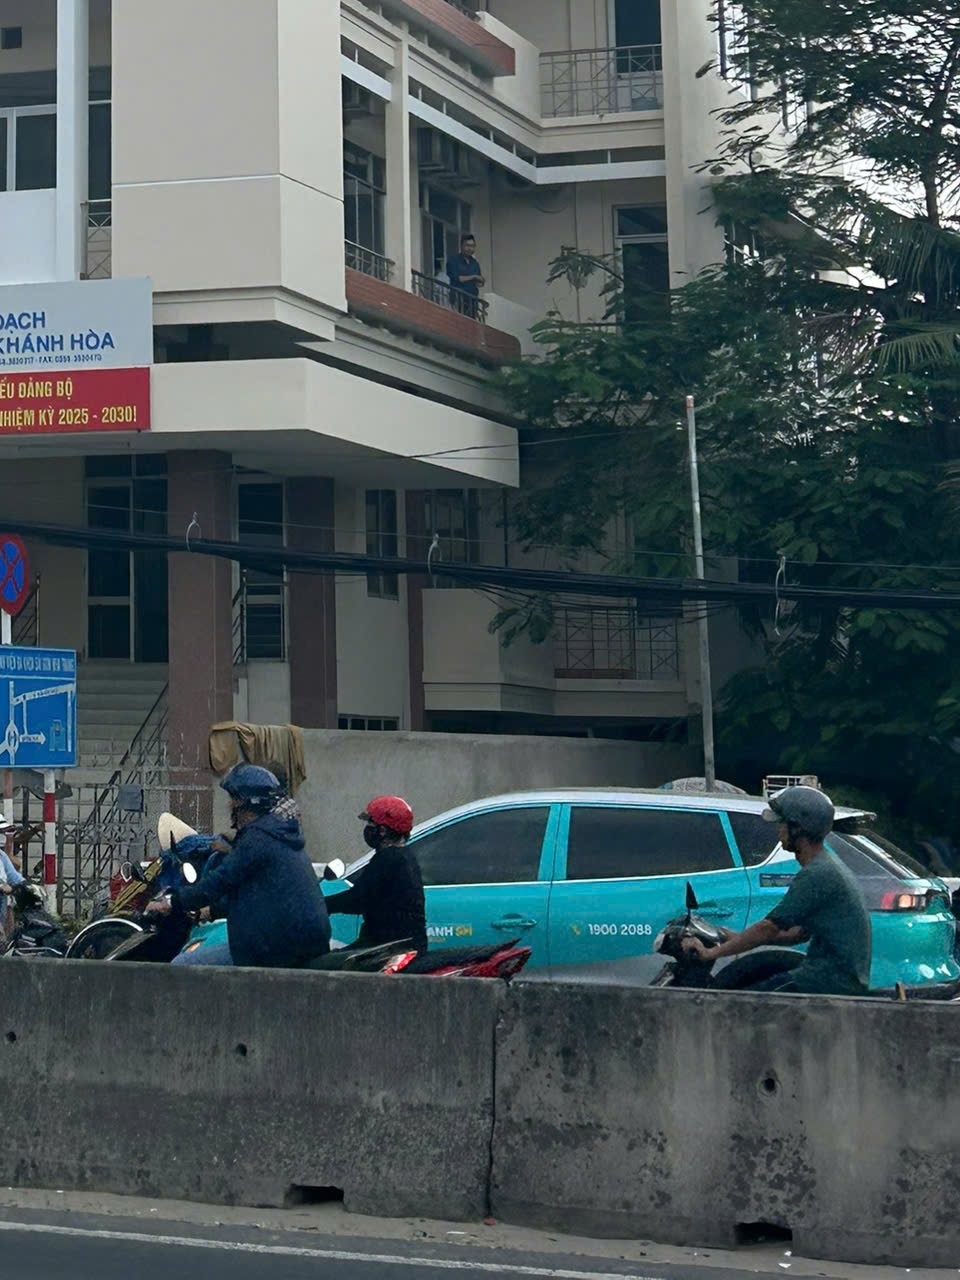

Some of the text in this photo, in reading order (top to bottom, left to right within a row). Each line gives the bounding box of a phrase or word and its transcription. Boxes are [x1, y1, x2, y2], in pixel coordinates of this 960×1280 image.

[70, 329, 115, 350] HÒA
[18, 376, 53, 398] ĐẢNG
[56, 377, 73, 400] BỘ
[39, 405, 54, 425] KỲ
[58, 408, 89, 425] 2025
[101, 405, 137, 423] 2030!
[426, 926, 453, 937] ANH
[588, 923, 652, 936] 1900 2088
